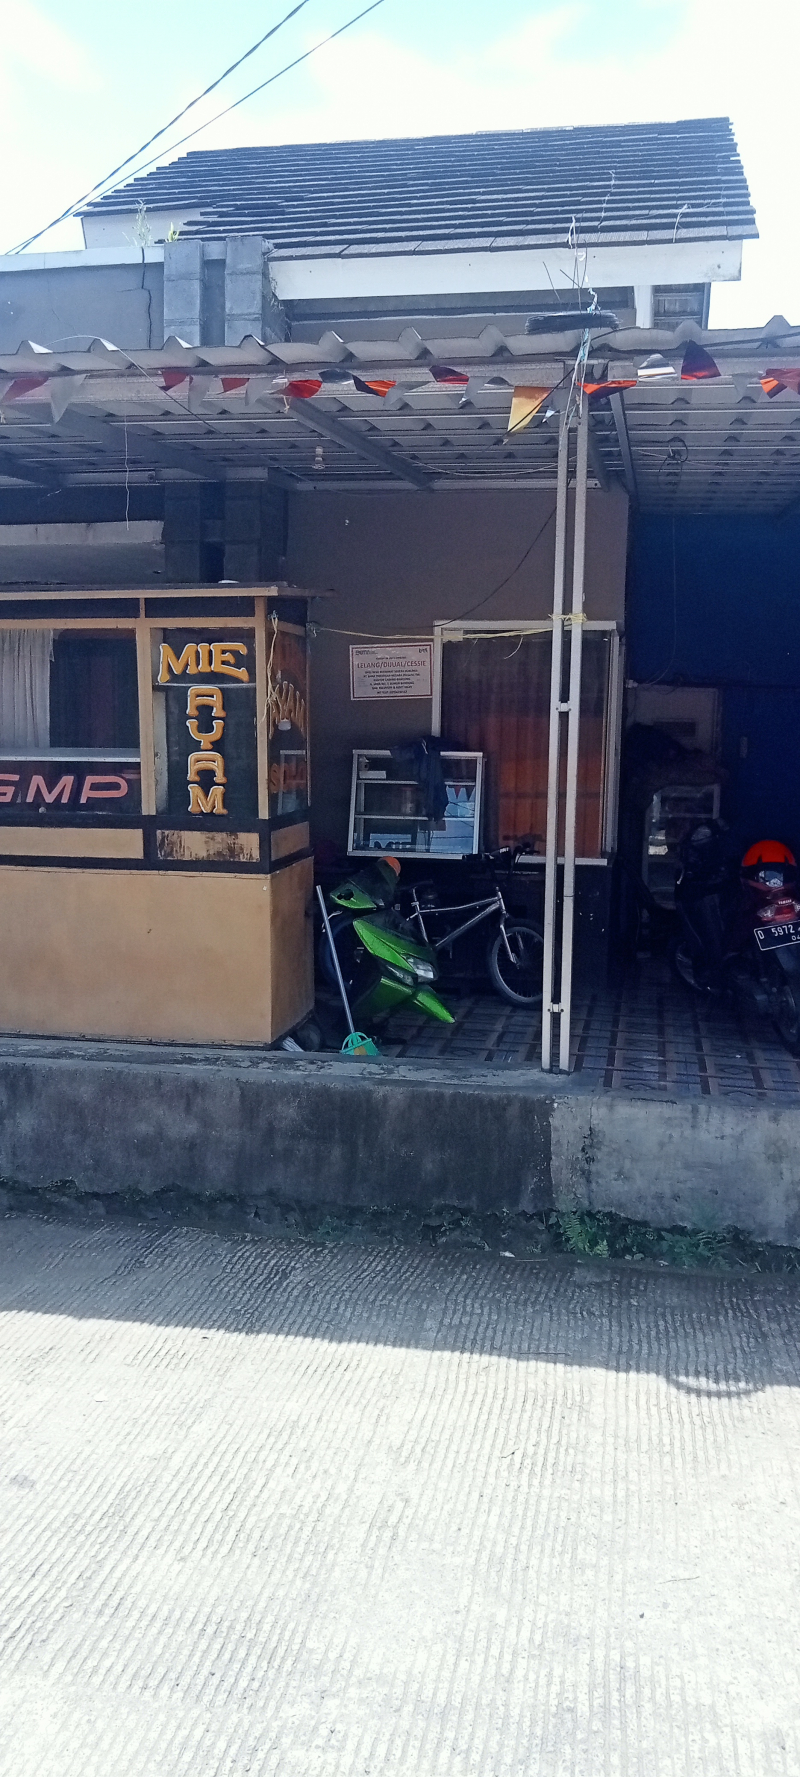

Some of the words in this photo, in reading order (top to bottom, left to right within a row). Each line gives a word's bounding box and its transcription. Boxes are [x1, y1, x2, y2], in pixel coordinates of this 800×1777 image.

[158, 643, 249, 683] MIE
[186, 686, 228, 815] AYAM
[757, 930, 765, 940] D
[771, 924, 795, 937] 5972
